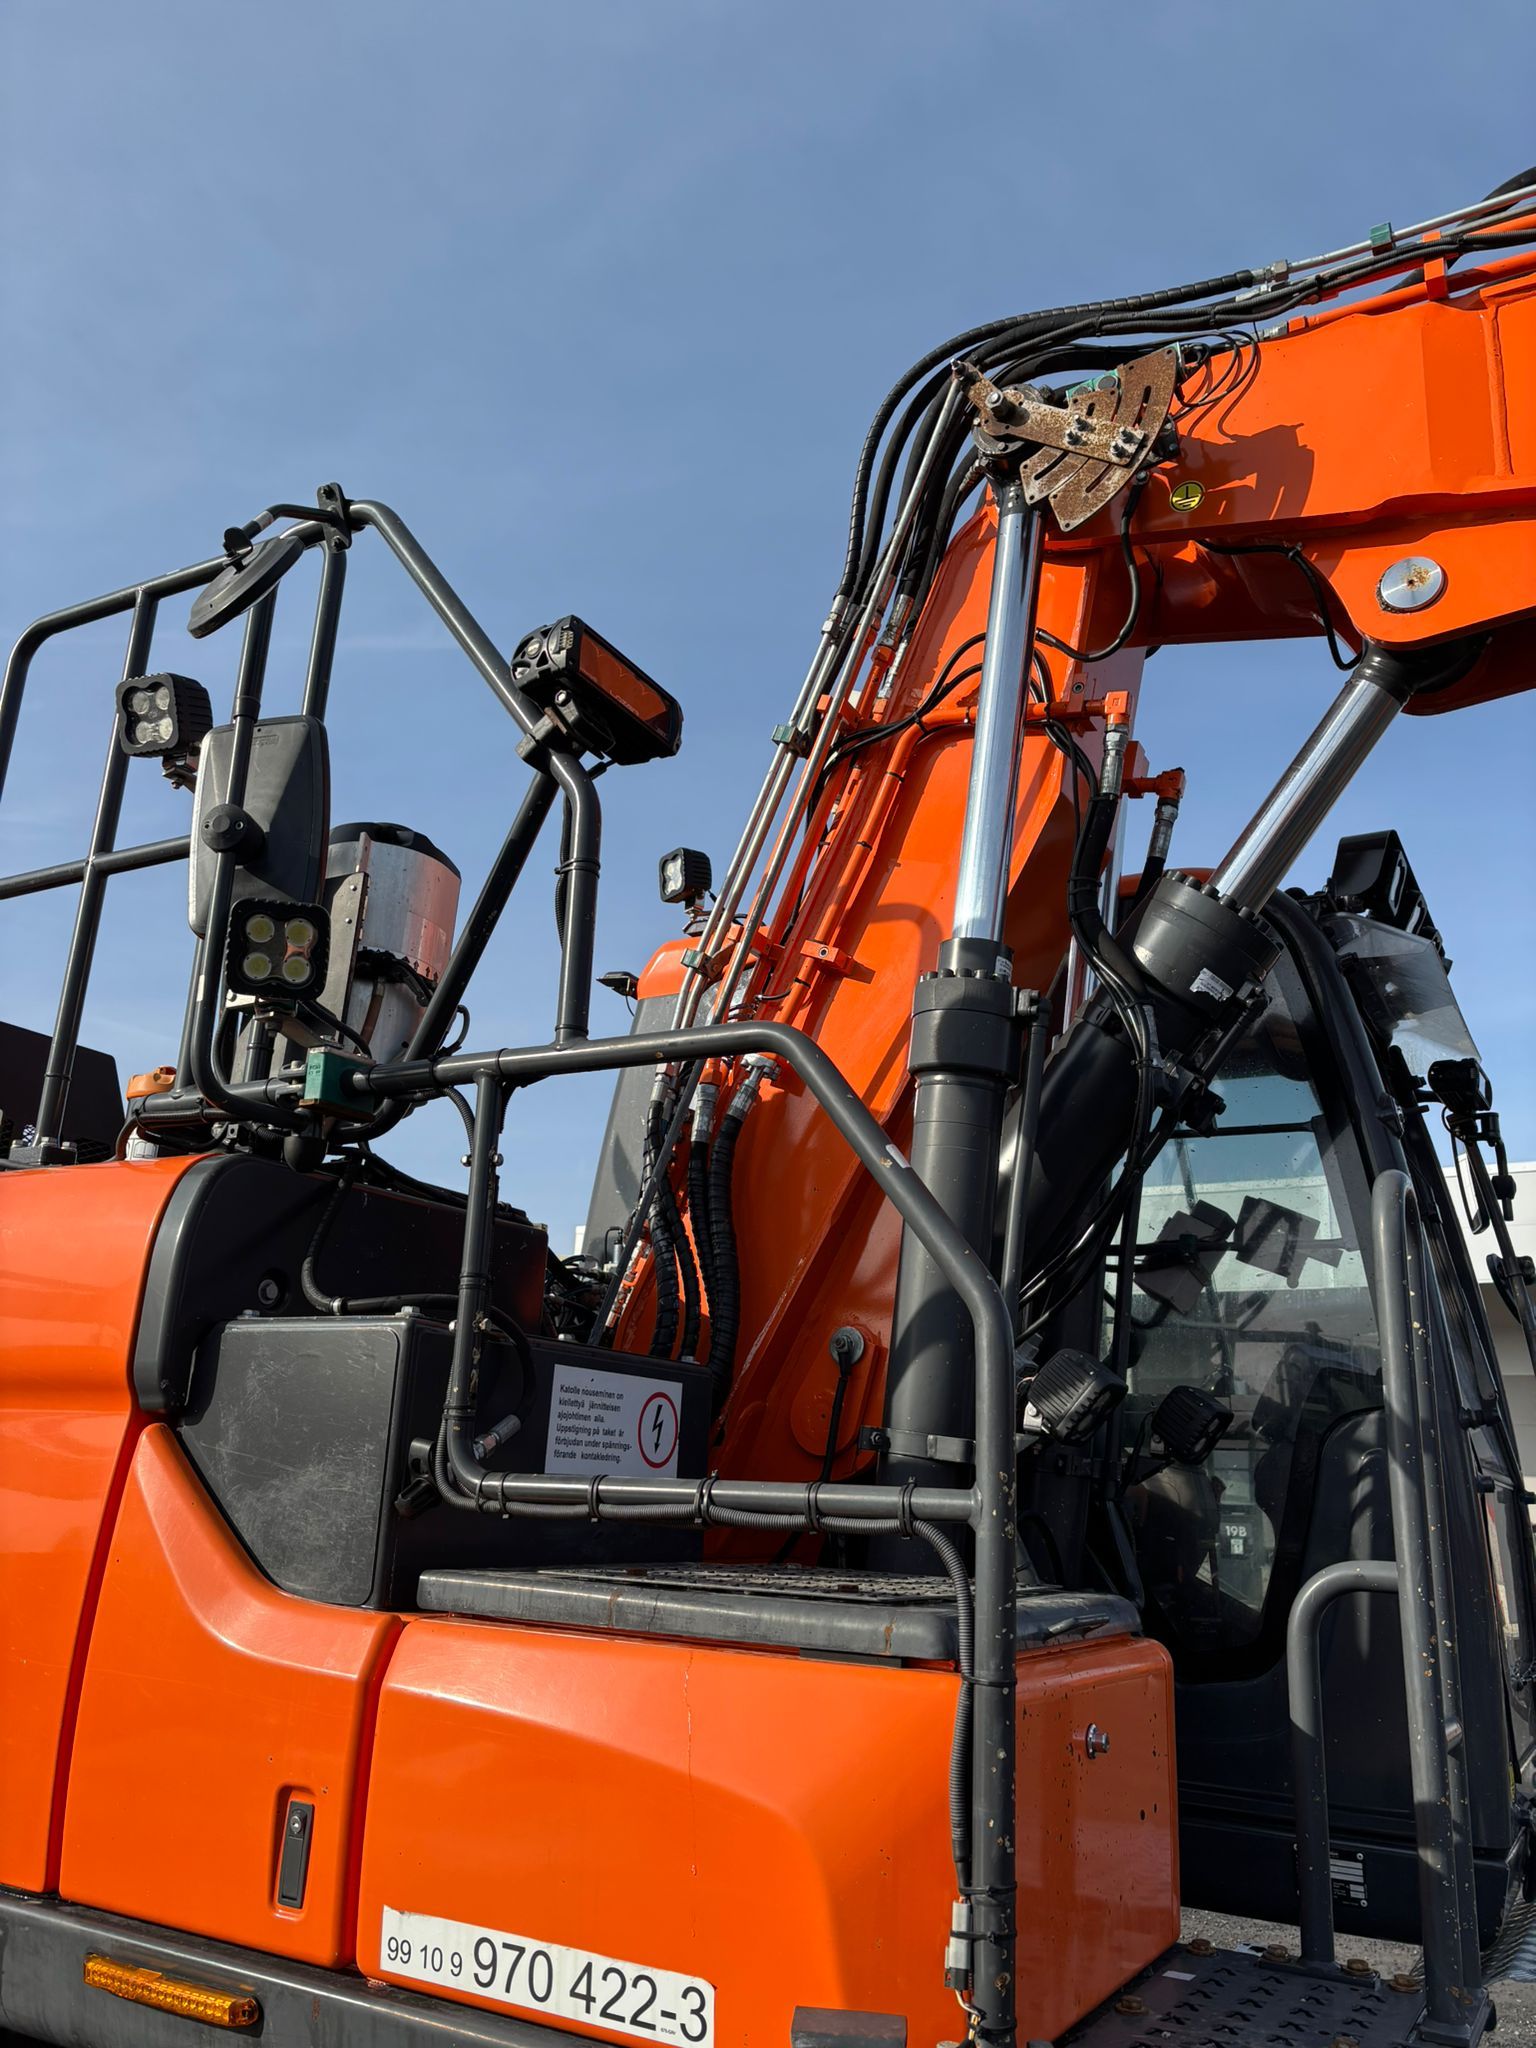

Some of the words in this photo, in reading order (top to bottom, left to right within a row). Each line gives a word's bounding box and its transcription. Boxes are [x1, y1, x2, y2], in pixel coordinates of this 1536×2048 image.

[560, 1384, 580, 1394] Katolle
[581, 1387, 615, 1399] nouseminen
[592, 1427, 600, 1436] på
[602, 1428, 616, 1436] taket
[619, 1428, 625, 1437] är
[584, 1439, 601, 1448] under
[554, 1449, 577, 1459] förande
[387, 1936, 412, 1964] 99
[419, 1944, 443, 1972] 10
[449, 1951, 463, 1977] 9
[473, 1936, 553, 2003] 970
[569, 1961, 707, 2042] 422-3
